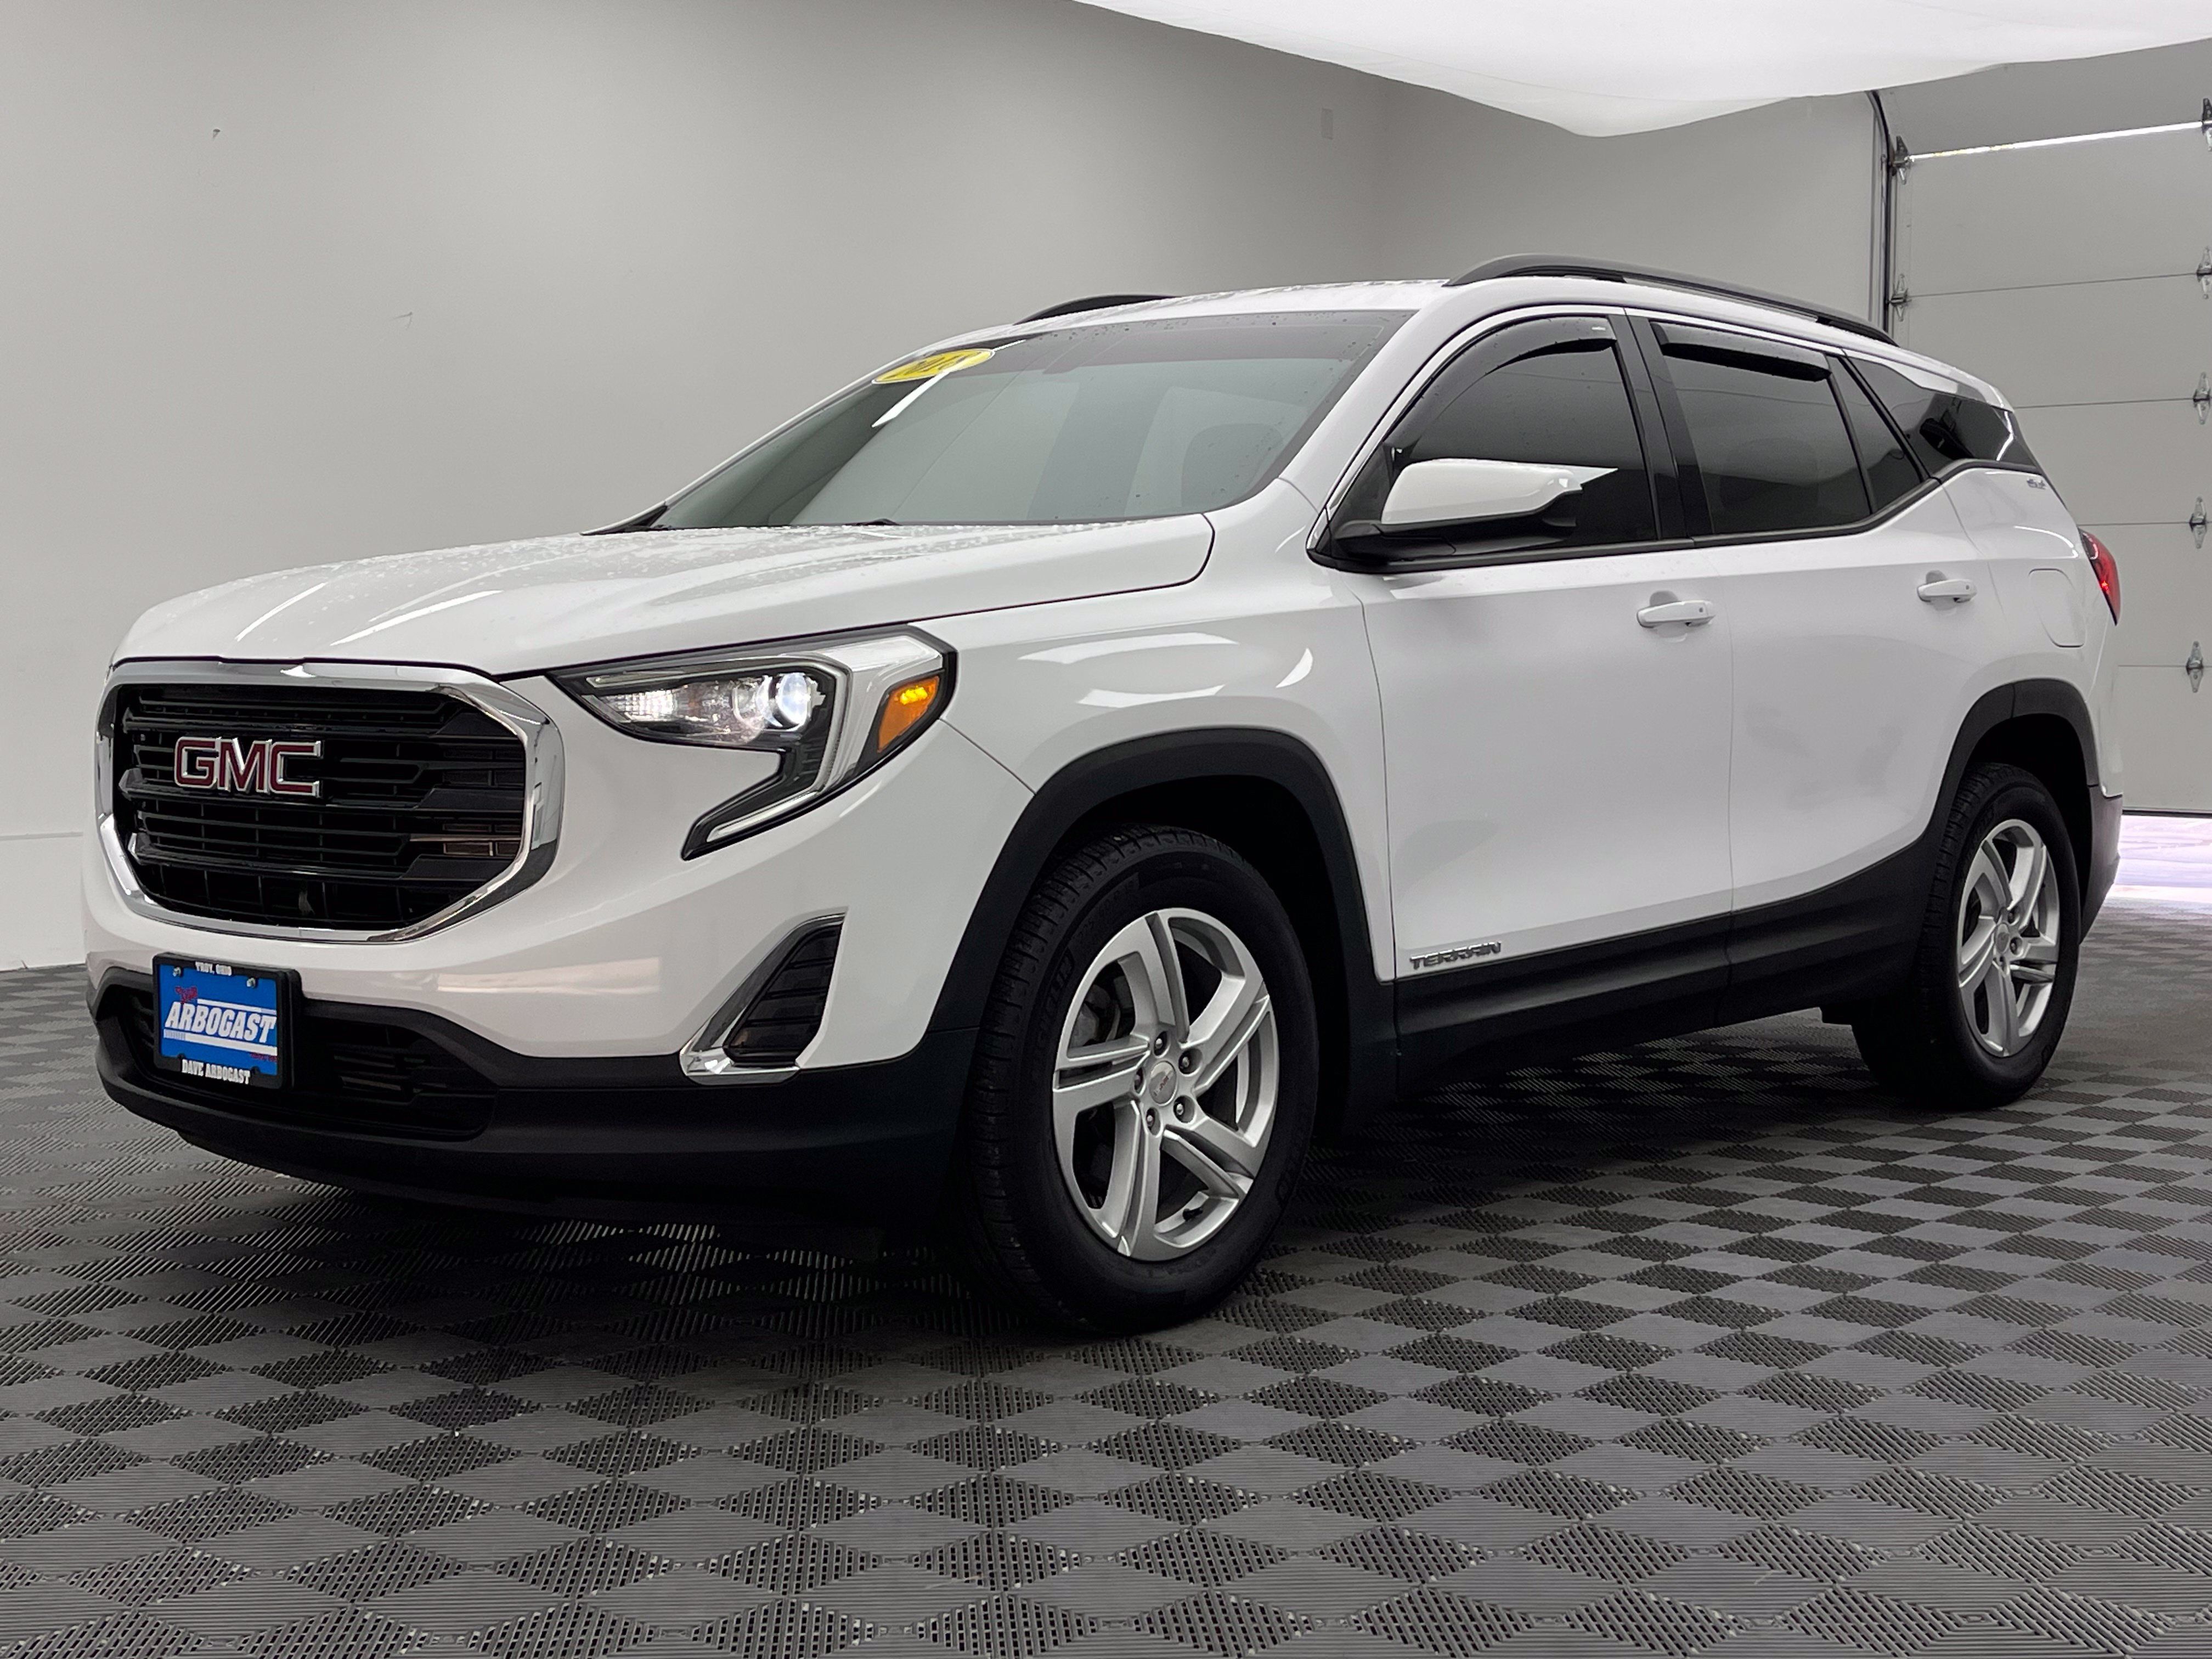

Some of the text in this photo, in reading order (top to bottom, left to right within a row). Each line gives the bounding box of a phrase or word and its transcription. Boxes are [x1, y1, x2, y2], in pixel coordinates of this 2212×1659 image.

[174, 737, 320, 798] GMC
[1409, 941, 1502, 970] TERRAIN
[165, 1001, 277, 1042] ARBOGAST
[182, 1059, 250, 1085] DAVE ARBOGAST
